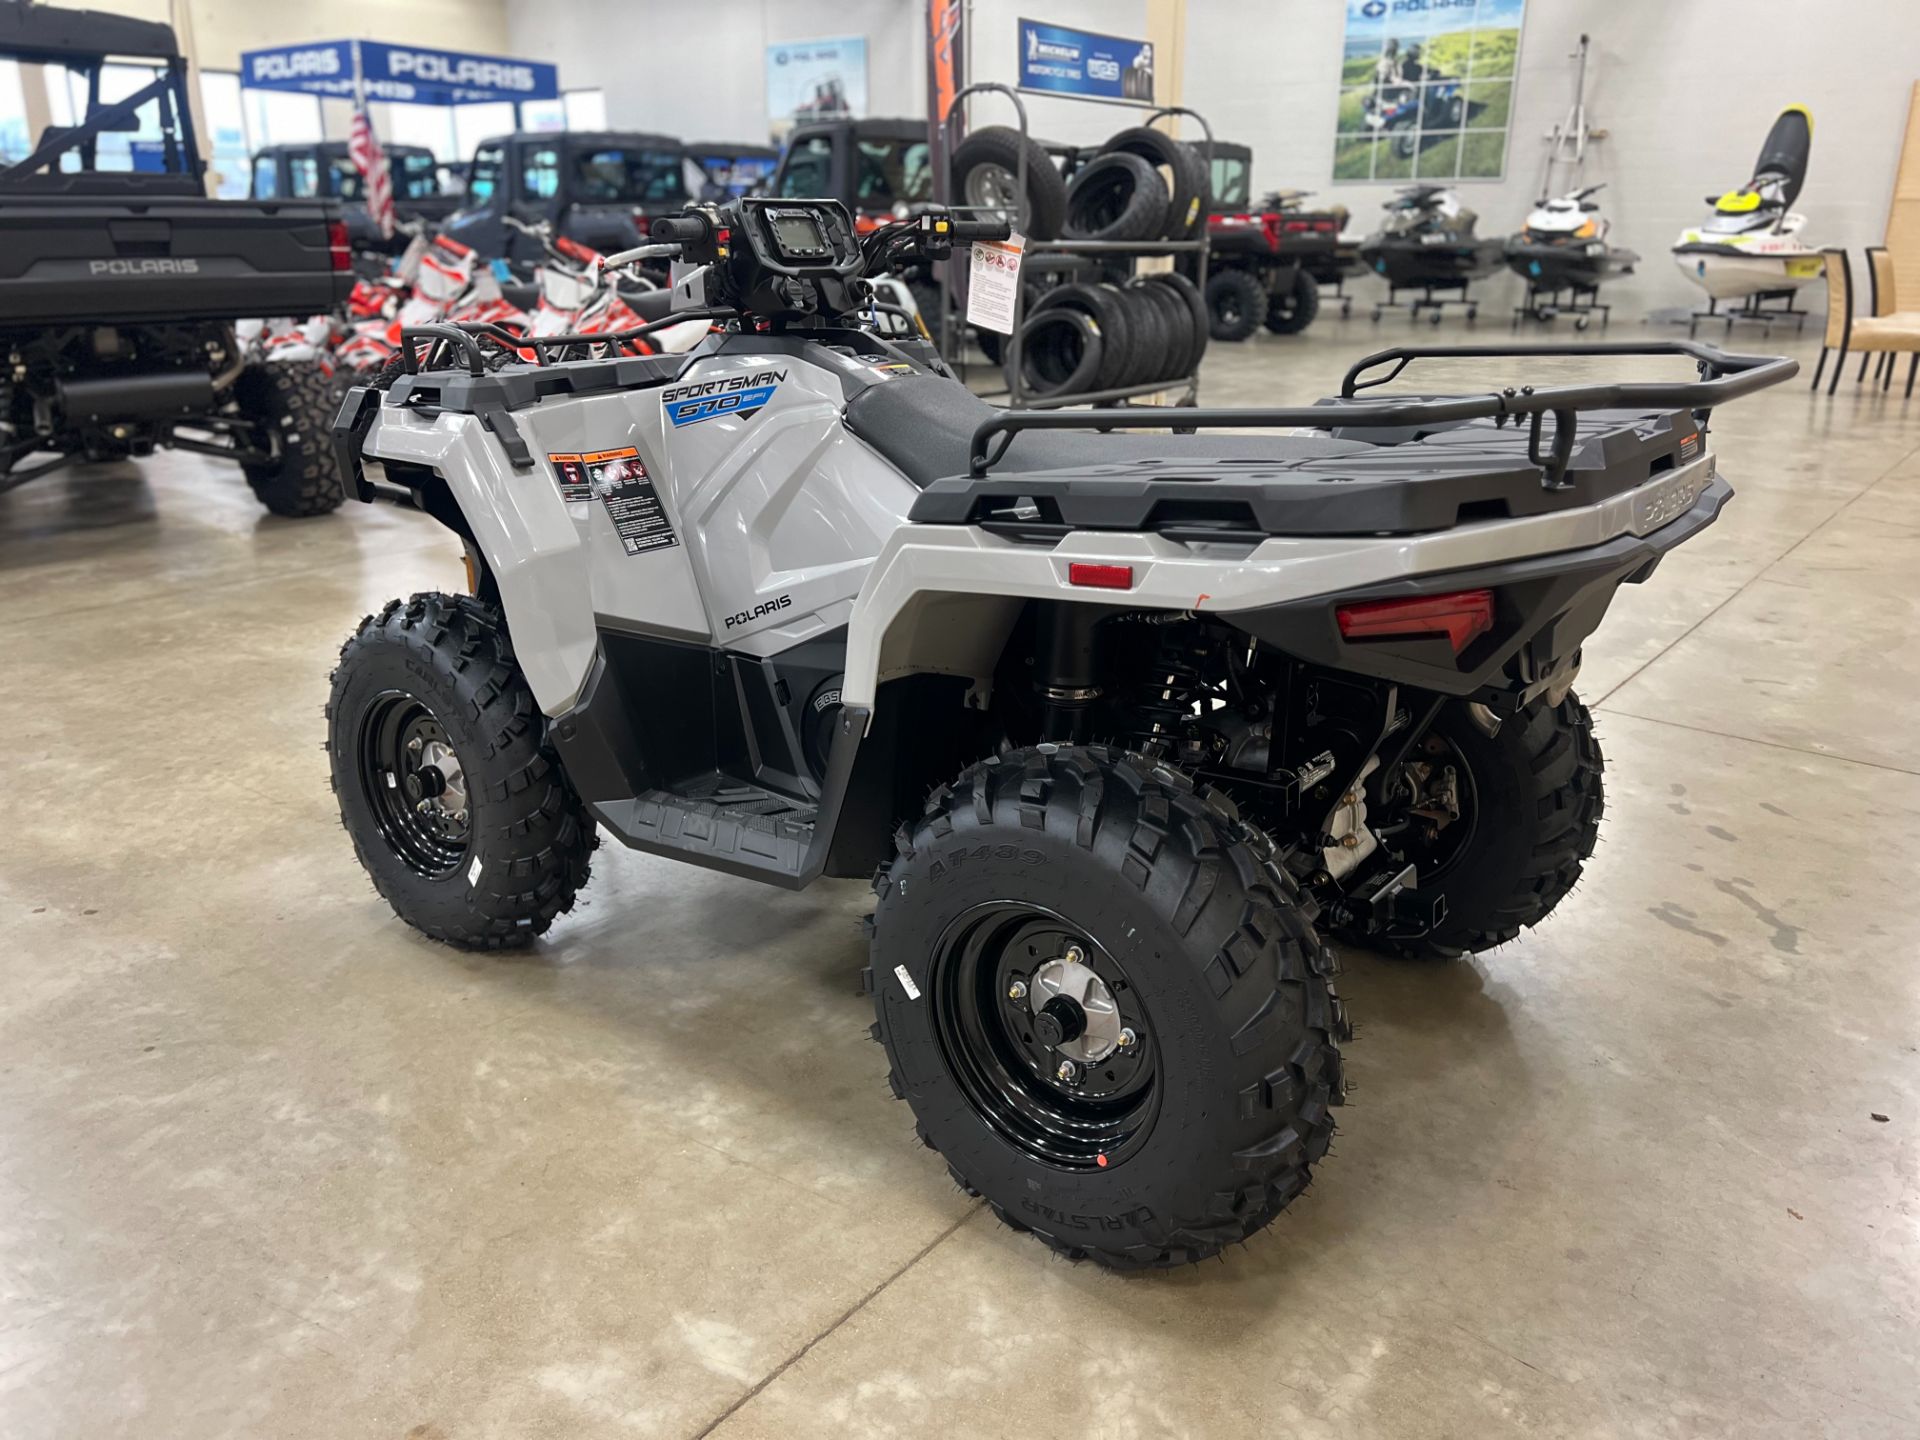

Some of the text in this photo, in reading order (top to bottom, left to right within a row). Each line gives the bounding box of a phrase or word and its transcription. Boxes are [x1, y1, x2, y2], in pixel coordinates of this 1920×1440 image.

[253, 48, 340, 80] POLARIS
[387, 51, 535, 90] POLARIS
[89, 258, 199, 275] POLARIS
[661, 369, 788, 403] SPORTSMAN
[676, 392, 767, 419] 570 EFI
[725, 594, 792, 629] POLARIS
[816, 691, 839, 710] EBS
[928, 842, 1047, 886] AT489
